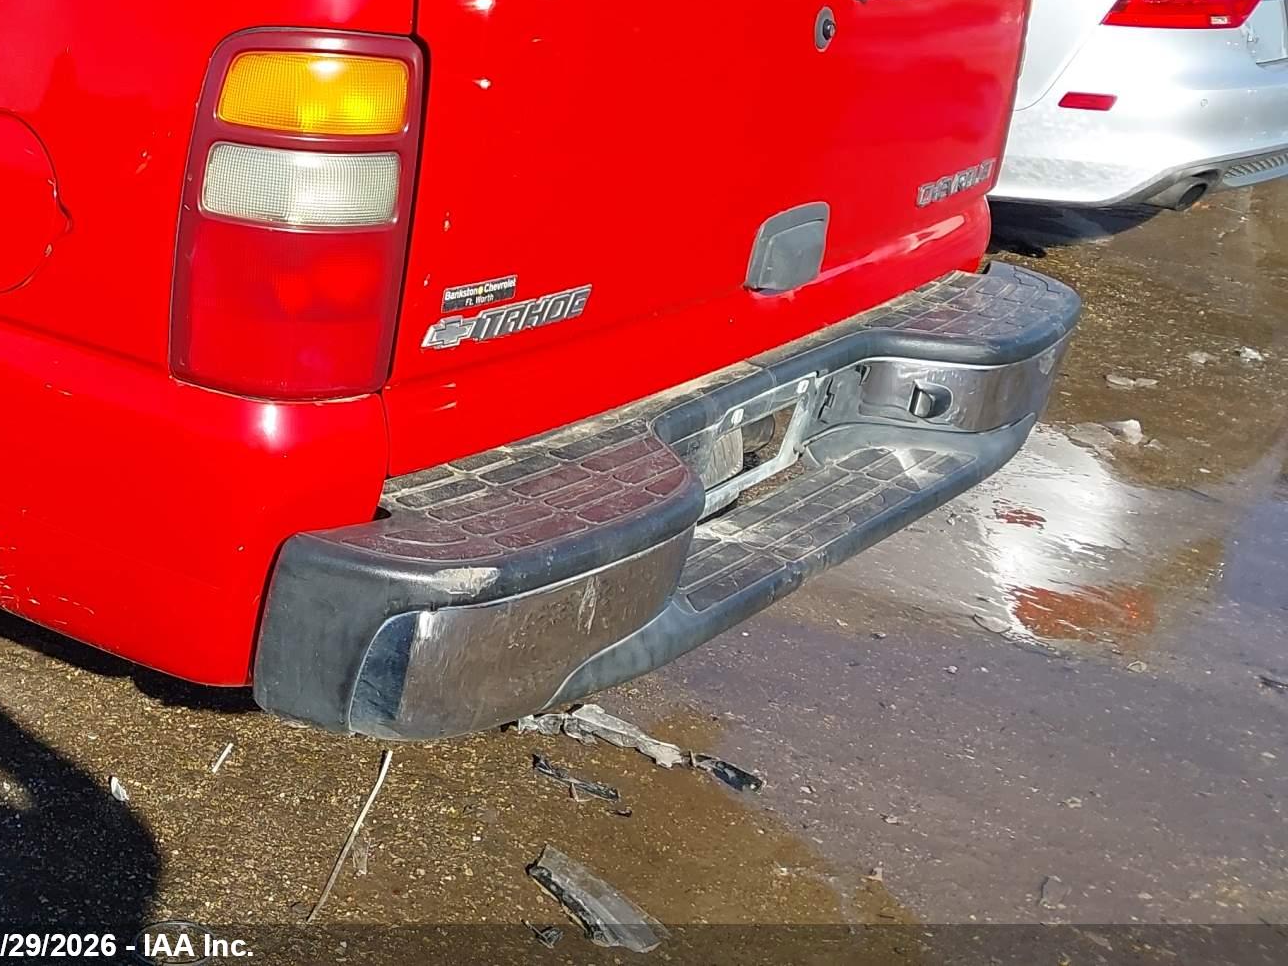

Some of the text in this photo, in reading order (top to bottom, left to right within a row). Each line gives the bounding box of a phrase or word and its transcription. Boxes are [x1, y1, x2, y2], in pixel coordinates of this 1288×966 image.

[444, 278, 516, 301] Bankston Chevrolet
[474, 284, 593, 341] TAHOE
